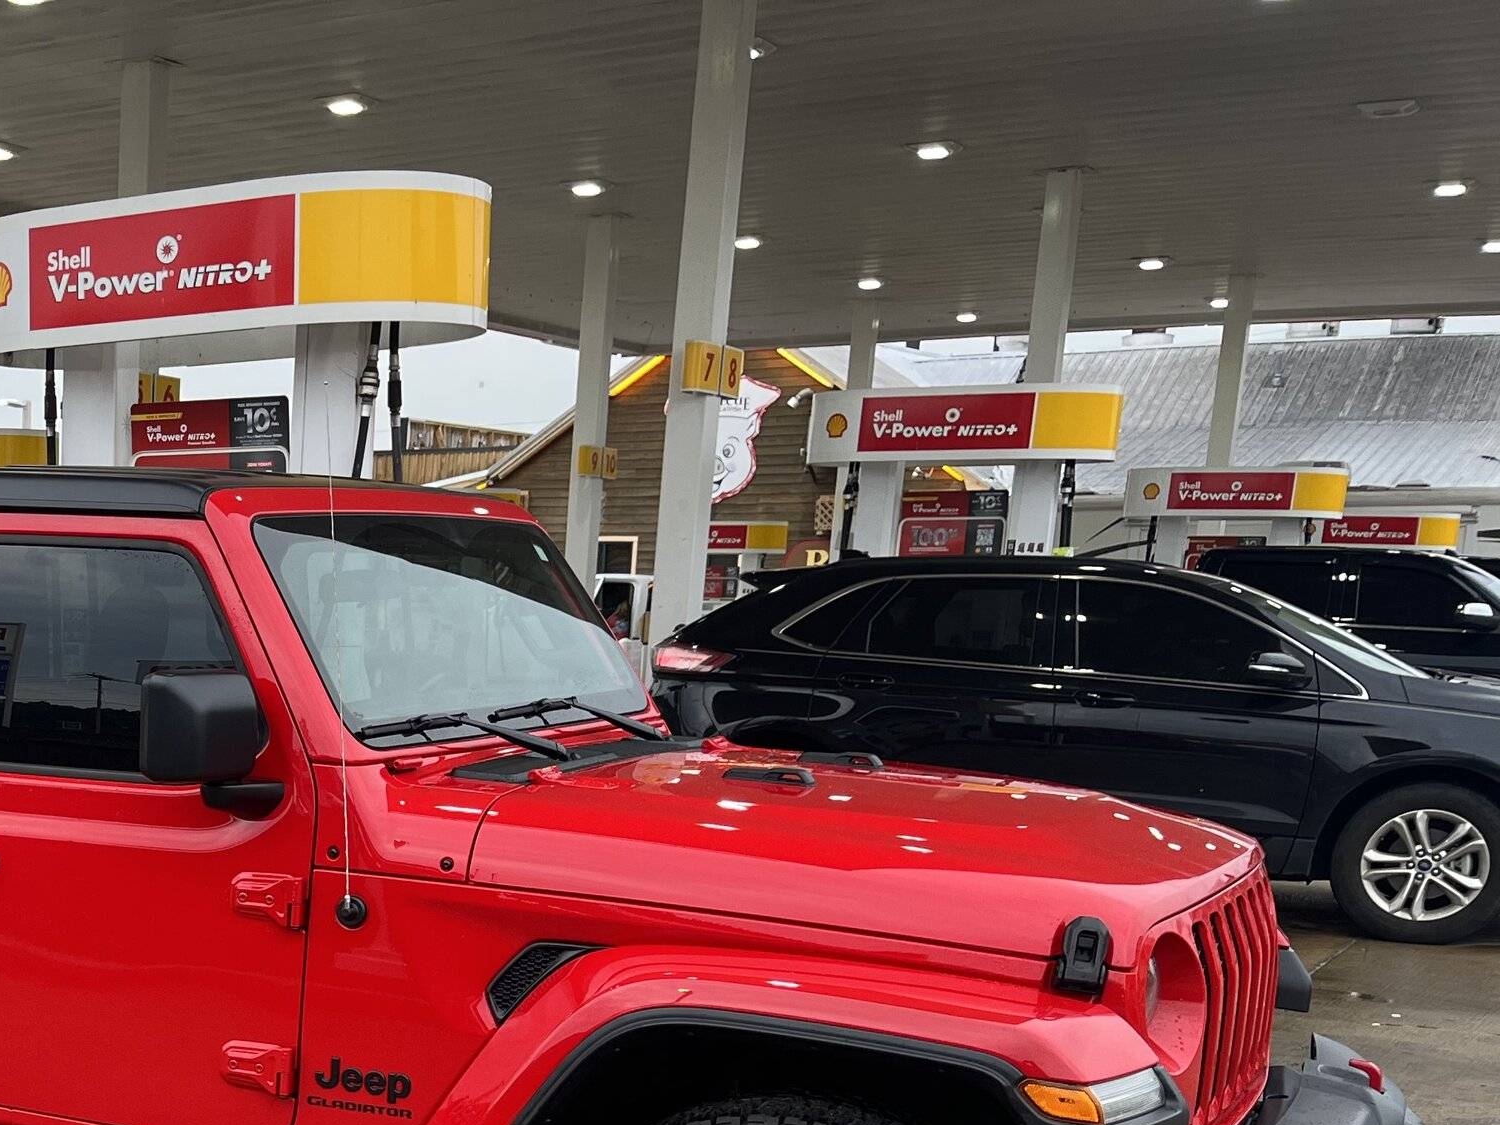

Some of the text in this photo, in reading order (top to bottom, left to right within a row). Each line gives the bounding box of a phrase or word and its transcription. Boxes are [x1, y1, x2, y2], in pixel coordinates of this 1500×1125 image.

[47, 245, 91, 272] Shell
[48, 267, 169, 303] V-Power
[704, 352, 716, 382] 7
[728, 358, 737, 389] 8
[873, 409, 903, 422] Shell
[147, 433, 185, 442] V-Power
[873, 423, 952, 438] V-Power
[591, 452, 599, 470] 9
[606, 454, 616, 474] 10
[1179, 481, 1201, 490] Shell
[1179, 490, 1236, 501] V-Power
[314, 1055, 412, 1104] Jeep
[307, 1095, 413, 1120] GLADIATOR
